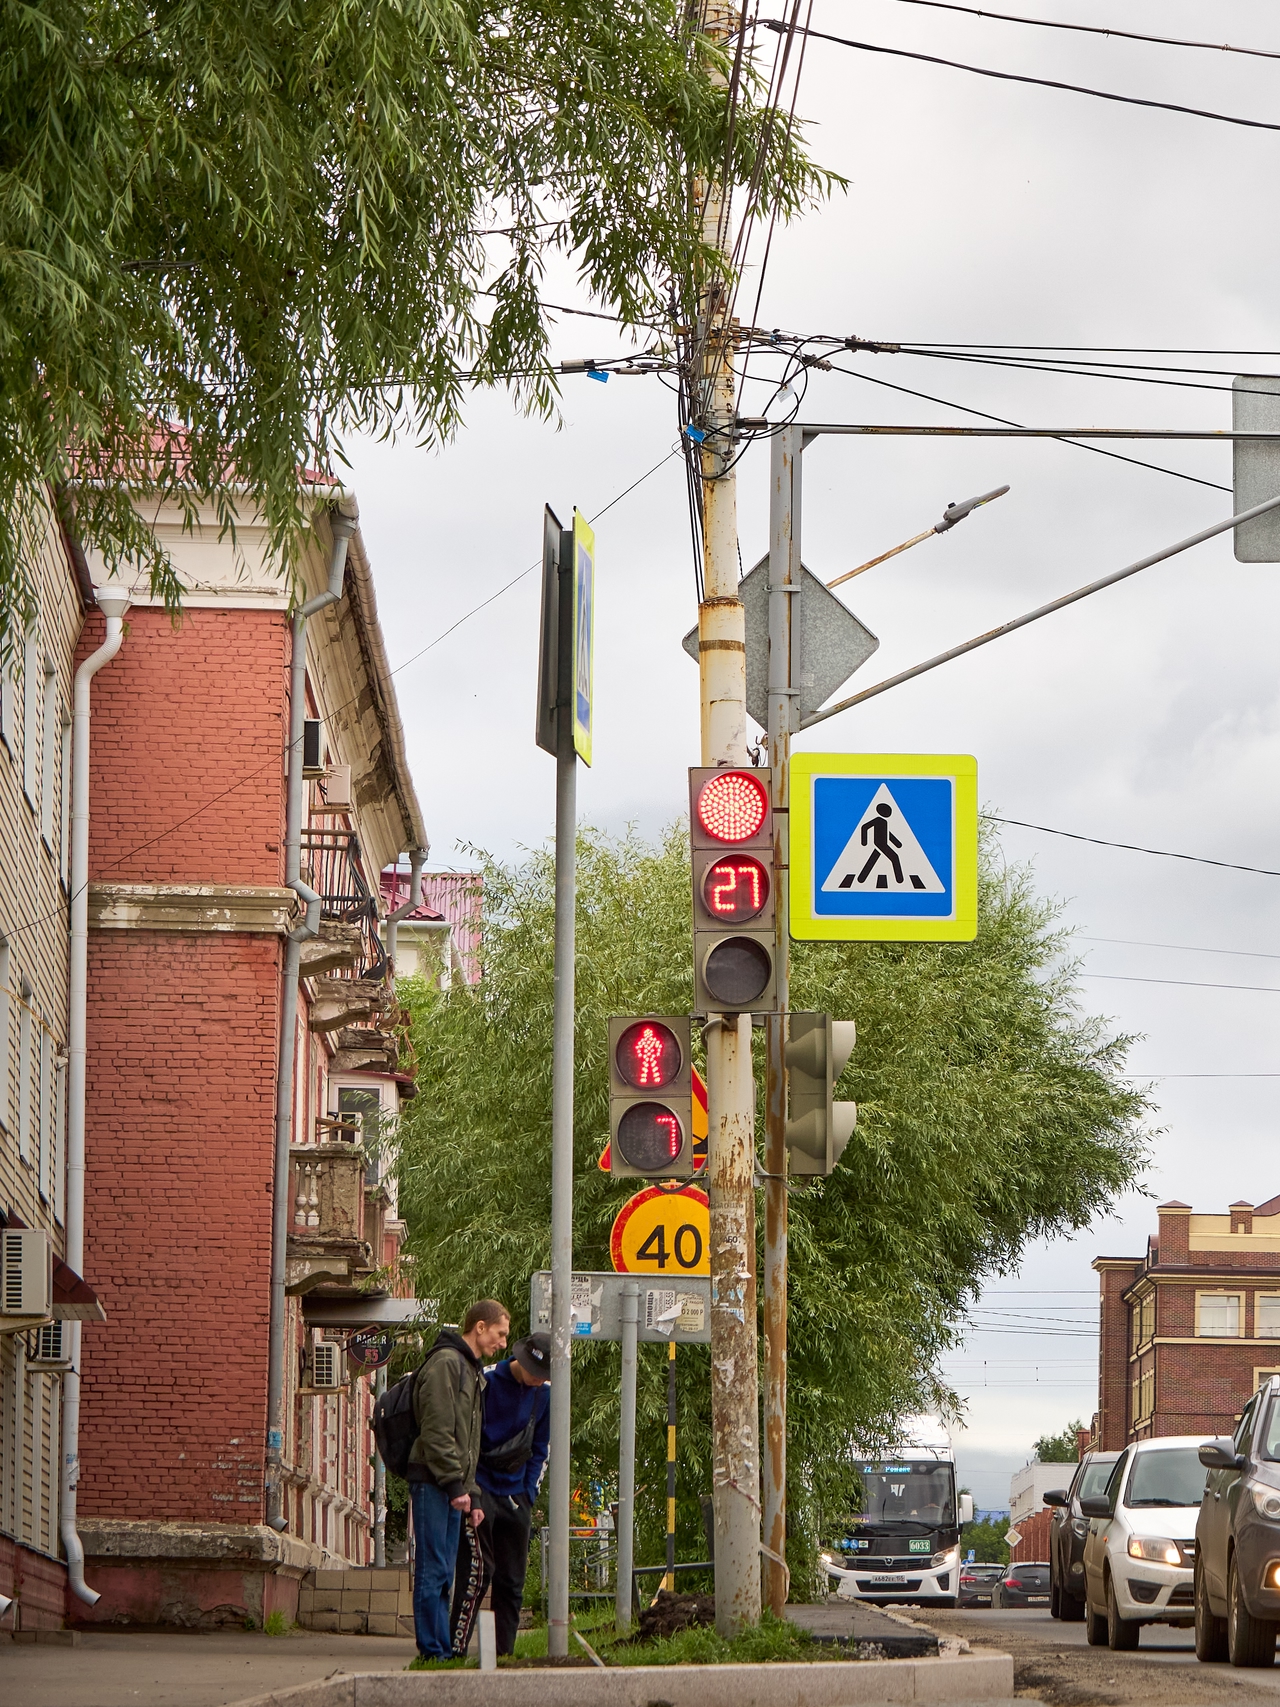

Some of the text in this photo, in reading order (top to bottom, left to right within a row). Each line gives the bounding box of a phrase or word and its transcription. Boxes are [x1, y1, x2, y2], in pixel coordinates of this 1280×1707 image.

[713, 866, 760, 910] 27
[656, 1116, 676, 1157] 7
[636, 1223, 702, 1269] 40
[910, 1541, 929, 1550] 6033
